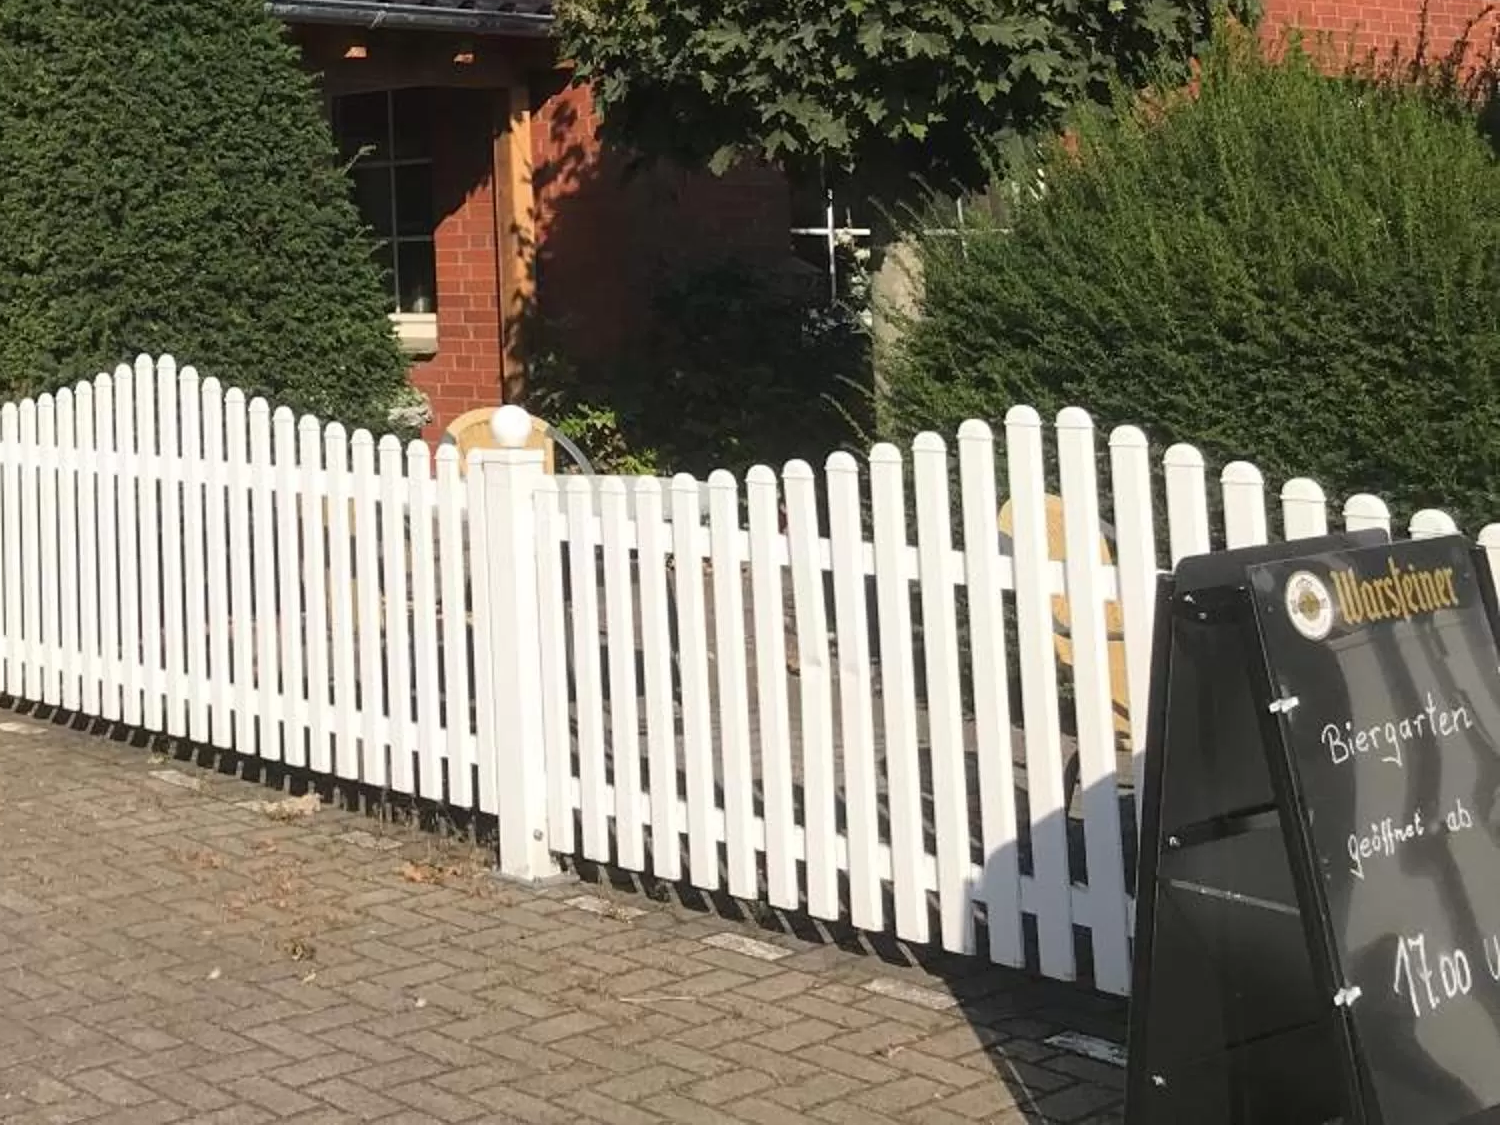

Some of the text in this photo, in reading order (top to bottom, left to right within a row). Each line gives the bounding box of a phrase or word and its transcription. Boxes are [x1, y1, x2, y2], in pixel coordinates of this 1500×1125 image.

[1329, 556, 1459, 625] Warsteiner
[1321, 691, 1473, 768] Biergarten
[1347, 798, 1473, 880] geöffnet ab
